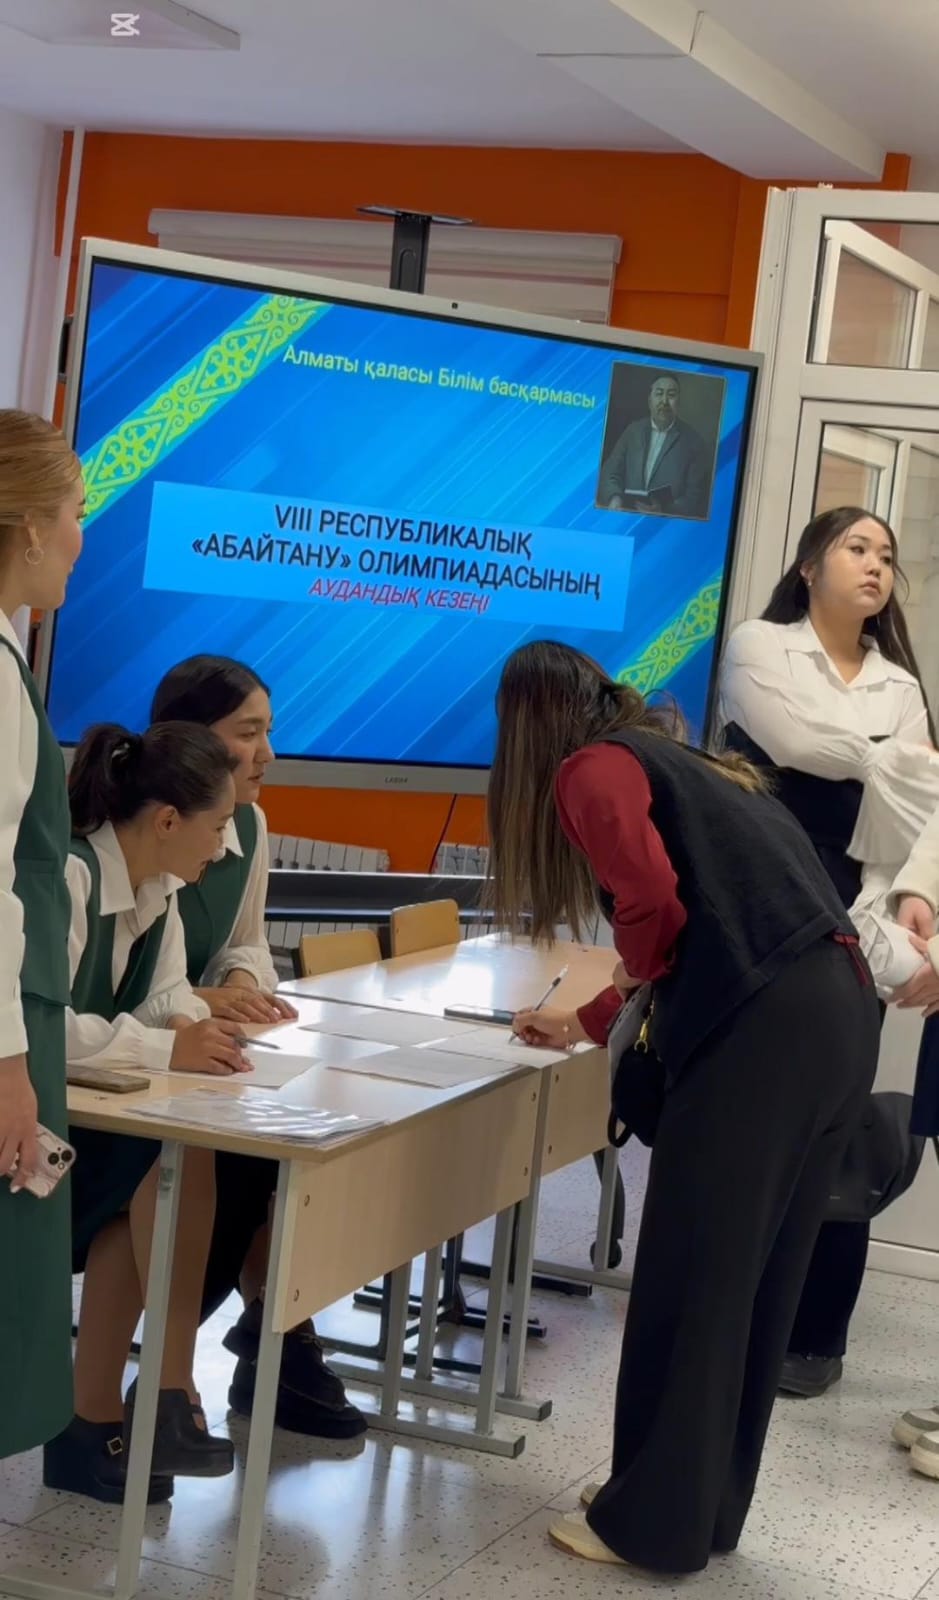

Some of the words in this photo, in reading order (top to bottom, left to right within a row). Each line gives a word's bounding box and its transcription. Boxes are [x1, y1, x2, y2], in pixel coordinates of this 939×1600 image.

[283, 344, 358, 374] Алматы
[364, 359, 432, 384] қаласы
[438, 367, 484, 392] Білім
[489, 375, 596, 409] басқармасы
[275, 503, 312, 532] VIII
[319, 509, 533, 561] РЕСПУБЛИКАЛЫҚ
[192, 532, 352, 569] «АБАЙТАНУ»
[358, 548, 601, 600] ОЛИМПИАДАСЫНЫҢ
[309, 578, 422, 609] АУДАНДЫҚ
[425, 588, 491, 615] КЕЗЕҢІ
